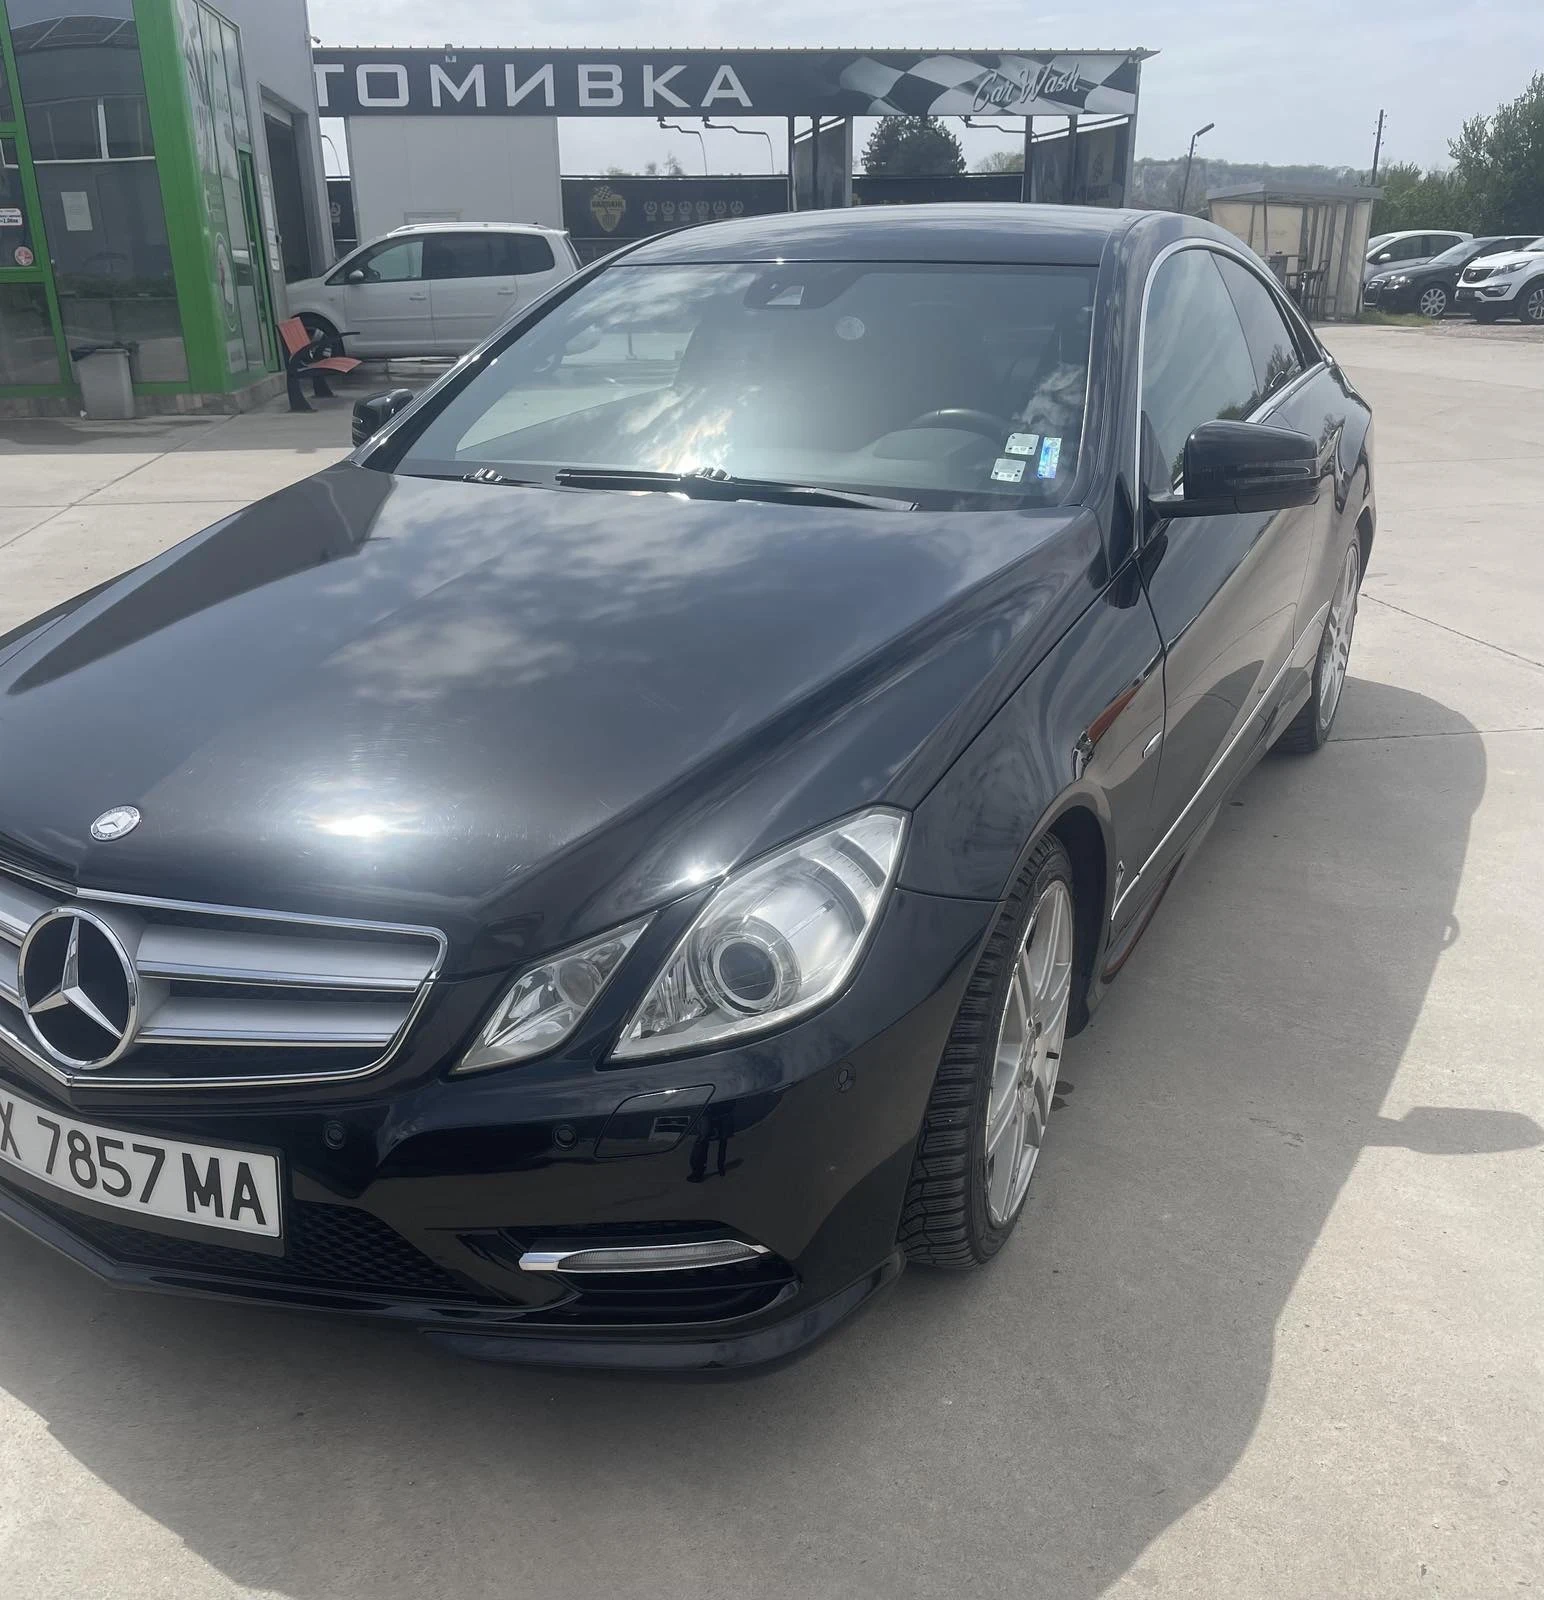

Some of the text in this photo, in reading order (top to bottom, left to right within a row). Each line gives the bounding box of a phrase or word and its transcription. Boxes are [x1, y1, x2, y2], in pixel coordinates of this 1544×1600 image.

[314, 63, 753, 108] ТОМИВКА
[973, 63, 1080, 112] Car Wash
[37, 1115, 166, 1203] 7857
[181, 1152, 267, 1225] MA
